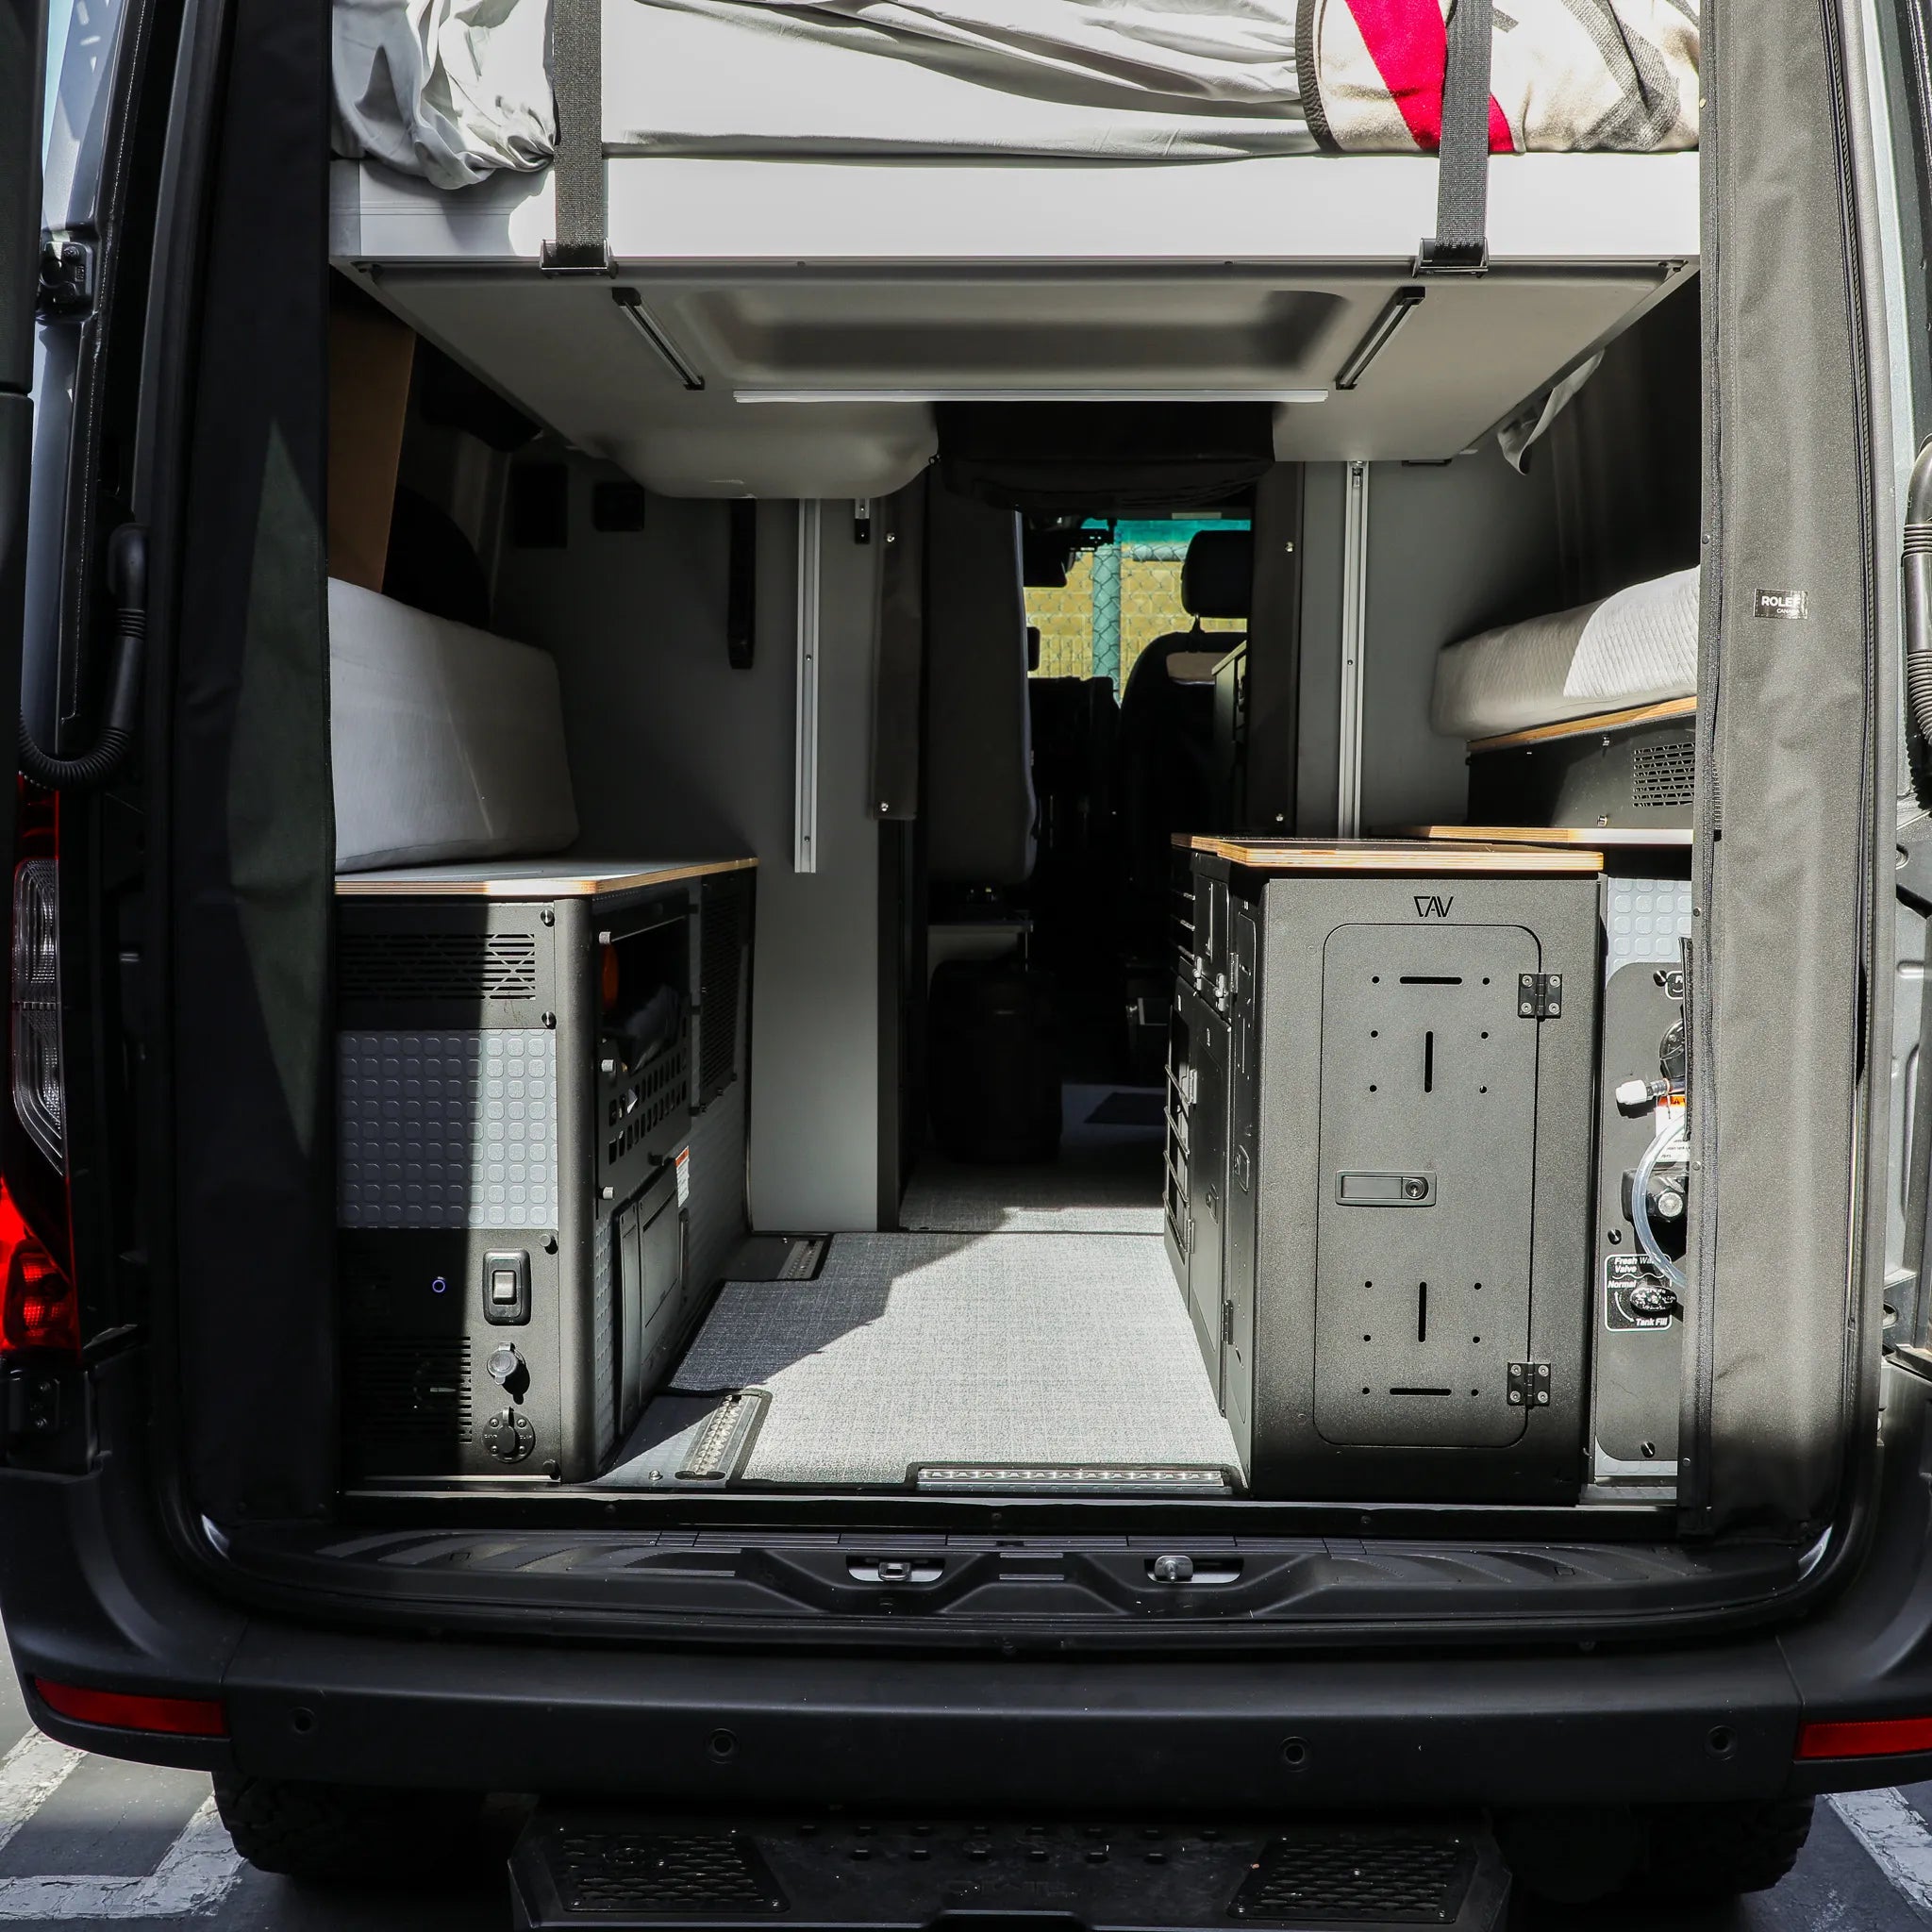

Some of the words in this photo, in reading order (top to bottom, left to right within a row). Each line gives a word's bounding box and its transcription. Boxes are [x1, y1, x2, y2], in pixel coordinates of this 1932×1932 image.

[1413, 895, 1455, 918] TAV
[1614, 1257, 1638, 1265] Fresh
[1614, 1264, 1638, 1274] Valve
[1607, 1279, 1637, 1289] Normal
[1636, 1317, 1655, 1326] Tank
[1656, 1317, 1668, 1326] Fill
